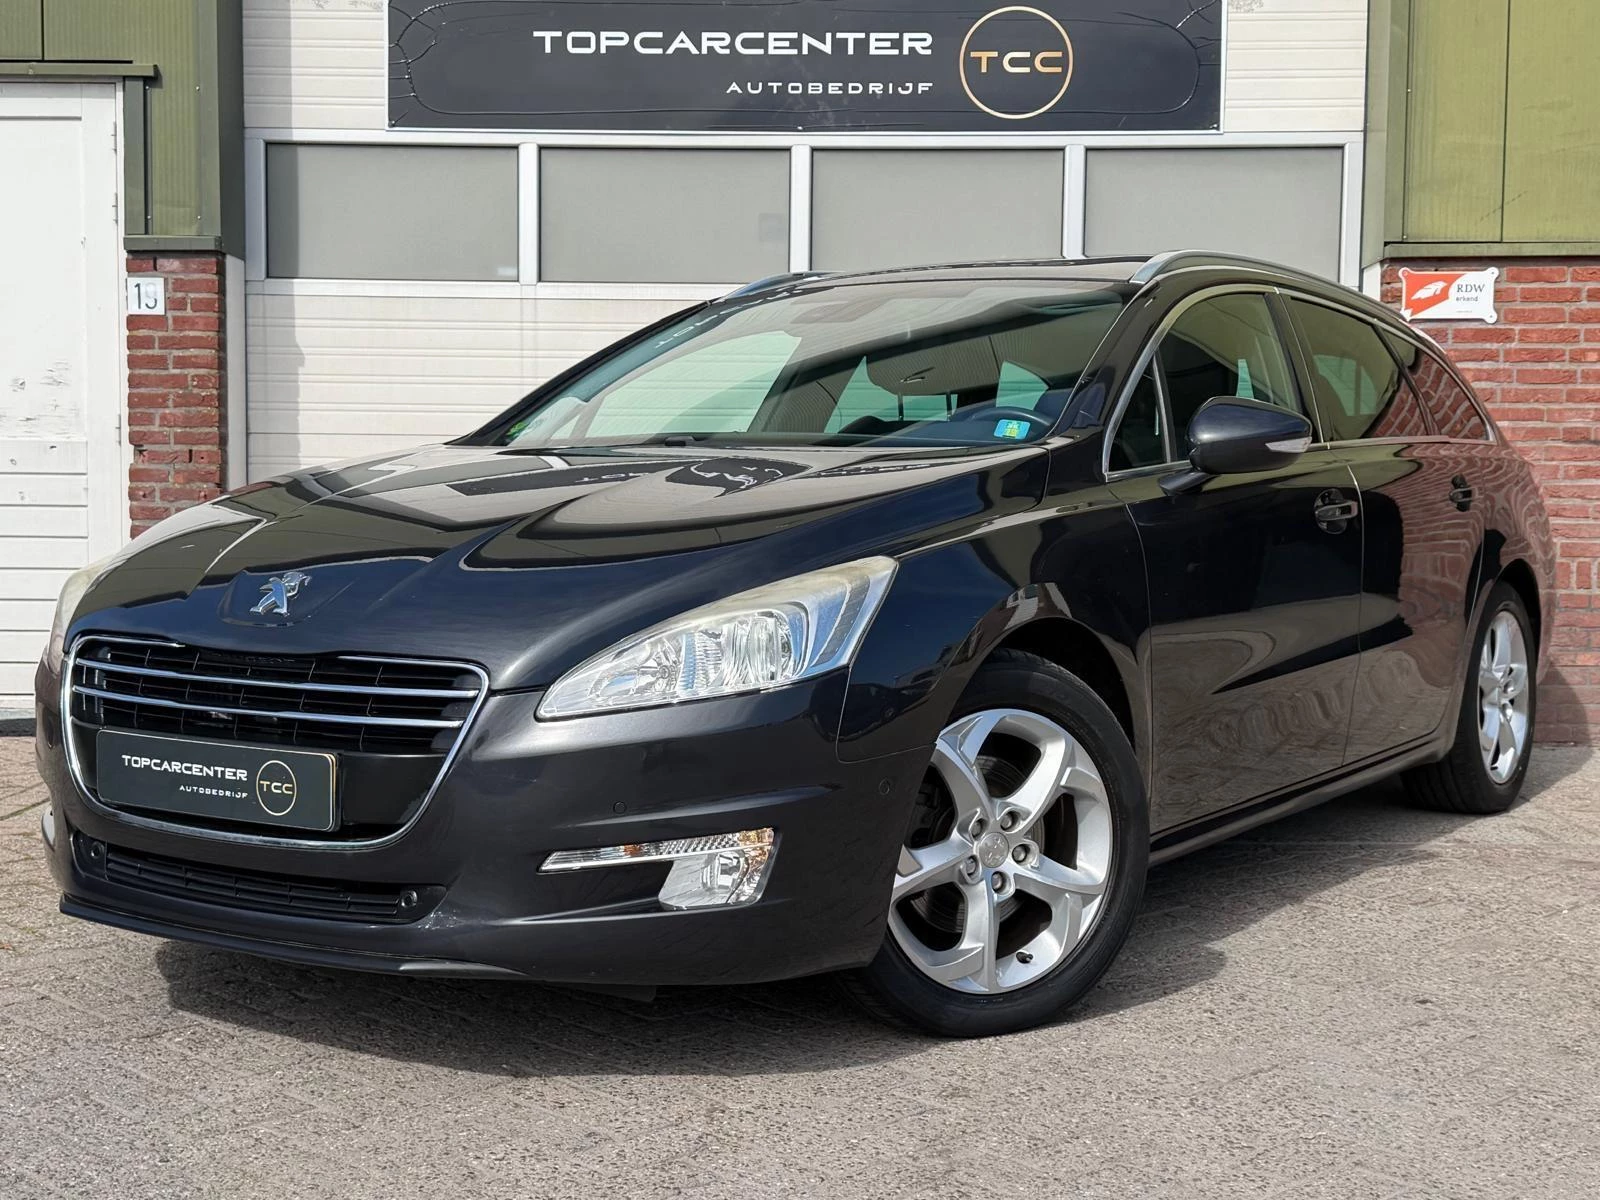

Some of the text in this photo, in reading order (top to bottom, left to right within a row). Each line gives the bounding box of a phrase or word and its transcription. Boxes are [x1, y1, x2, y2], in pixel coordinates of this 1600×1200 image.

[533, 30, 933, 56] TOPCARCENTER
[970, 51, 1064, 74] TCC
[726, 81, 934, 97] AUTOBEDRIJF
[1457, 284, 1485, 293] RDW
[121, 754, 248, 781] TOPCARCENTER
[179, 785, 249, 798] AUTOBEDRIJF
[259, 780, 294, 795] TCC
